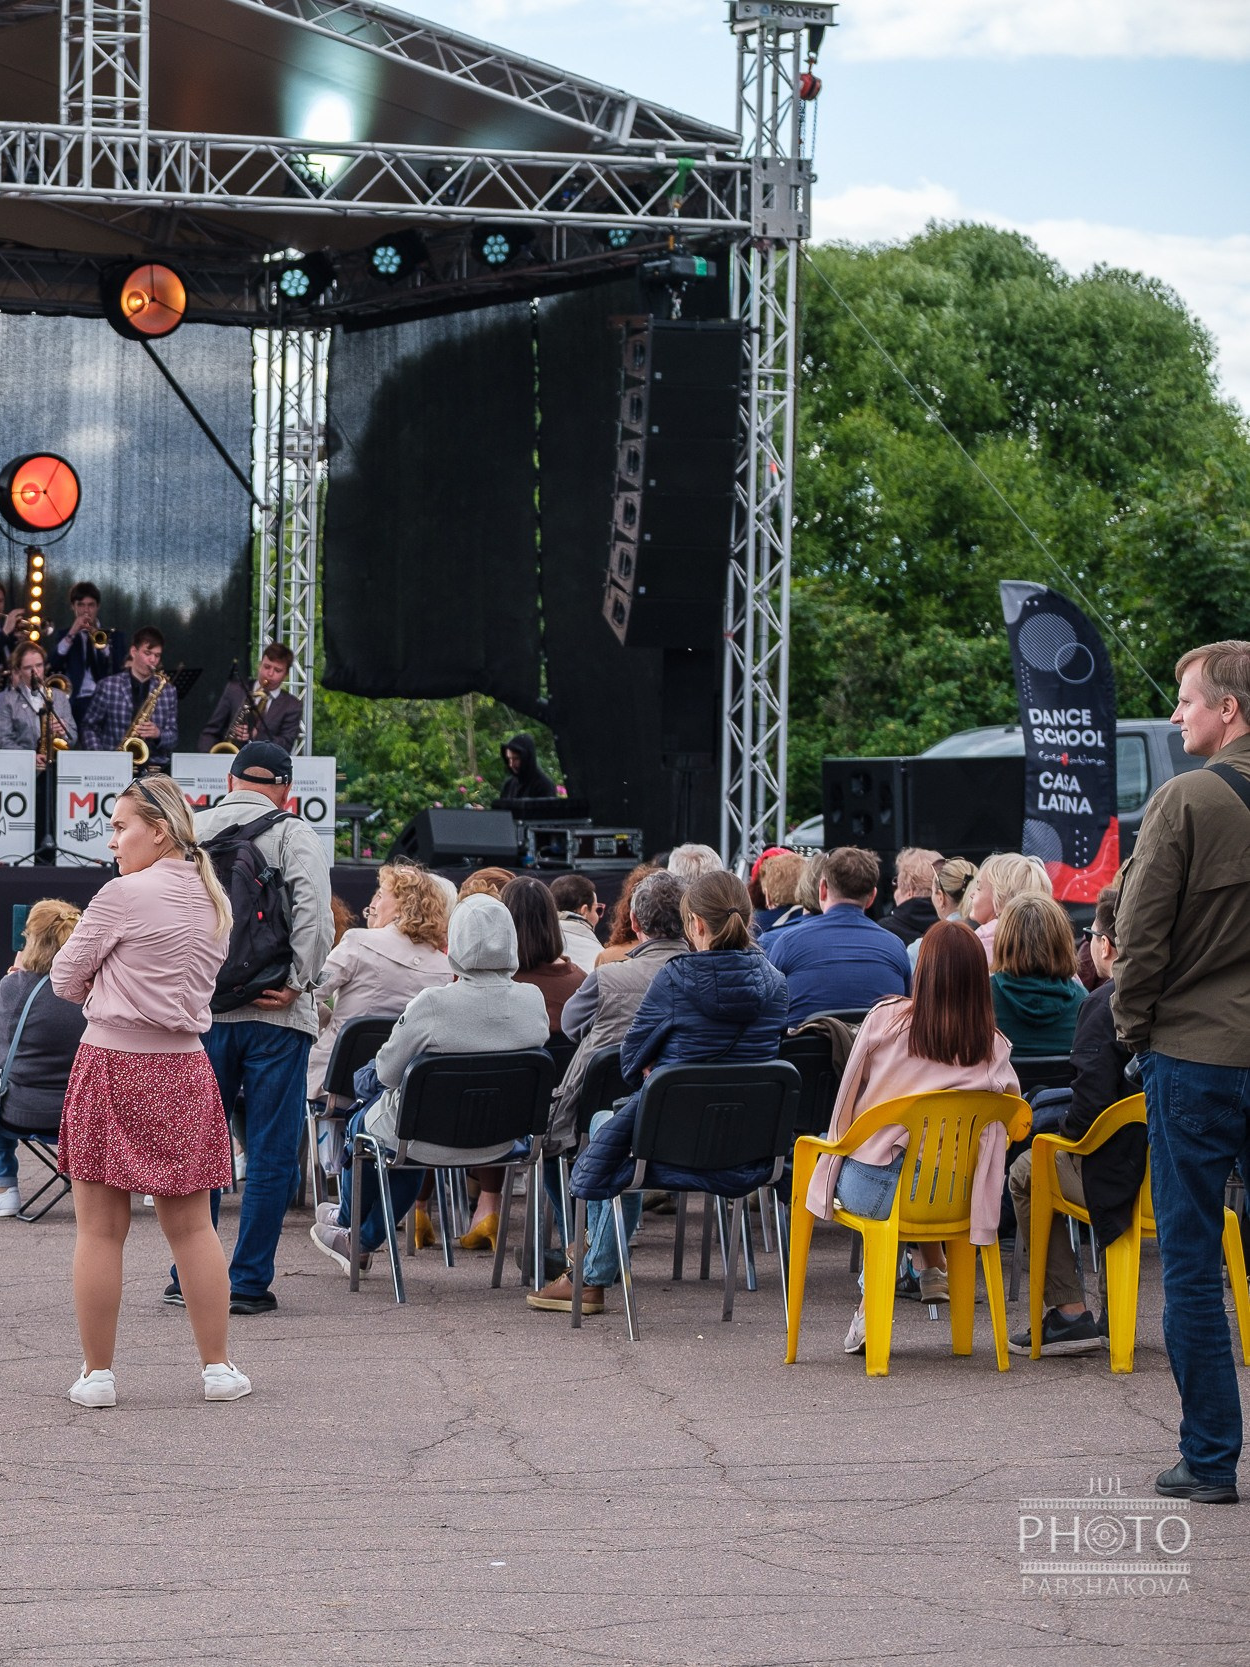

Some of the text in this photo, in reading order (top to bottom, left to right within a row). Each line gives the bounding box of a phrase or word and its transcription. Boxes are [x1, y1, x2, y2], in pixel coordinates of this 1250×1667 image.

[770, 4, 820, 19] PROLYTE
[1028, 708, 1092, 726] DANCE
[1032, 727, 1106, 748] SCHOOL
[1038, 771, 1081, 793] CASA
[1037, 792, 1093, 815] LATINA
